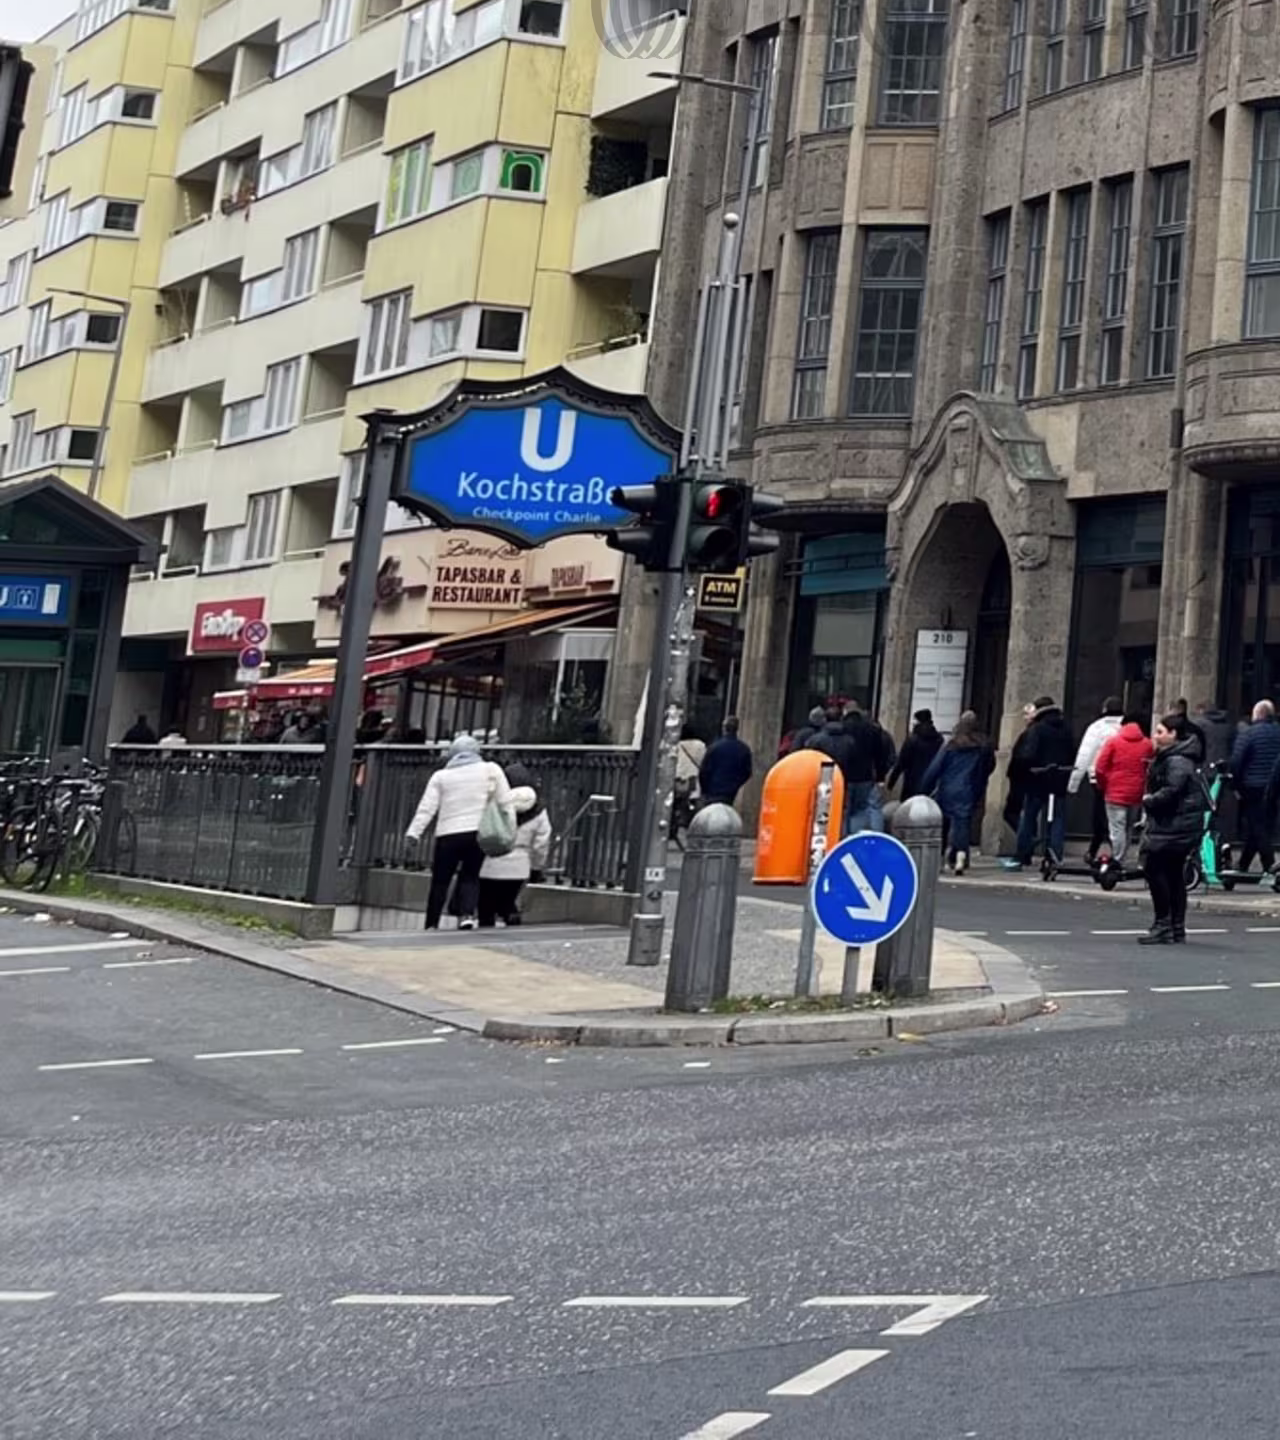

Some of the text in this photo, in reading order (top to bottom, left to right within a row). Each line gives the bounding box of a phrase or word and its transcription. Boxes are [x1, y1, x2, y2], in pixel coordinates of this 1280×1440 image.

[520, 407, 577, 472] U
[472, 506, 602, 524] Checkpoint Charlie
[436, 566, 522, 584] TAPASBAR &
[432, 586, 522, 604] RESTAURANT
[706, 580, 738, 594] ATM
